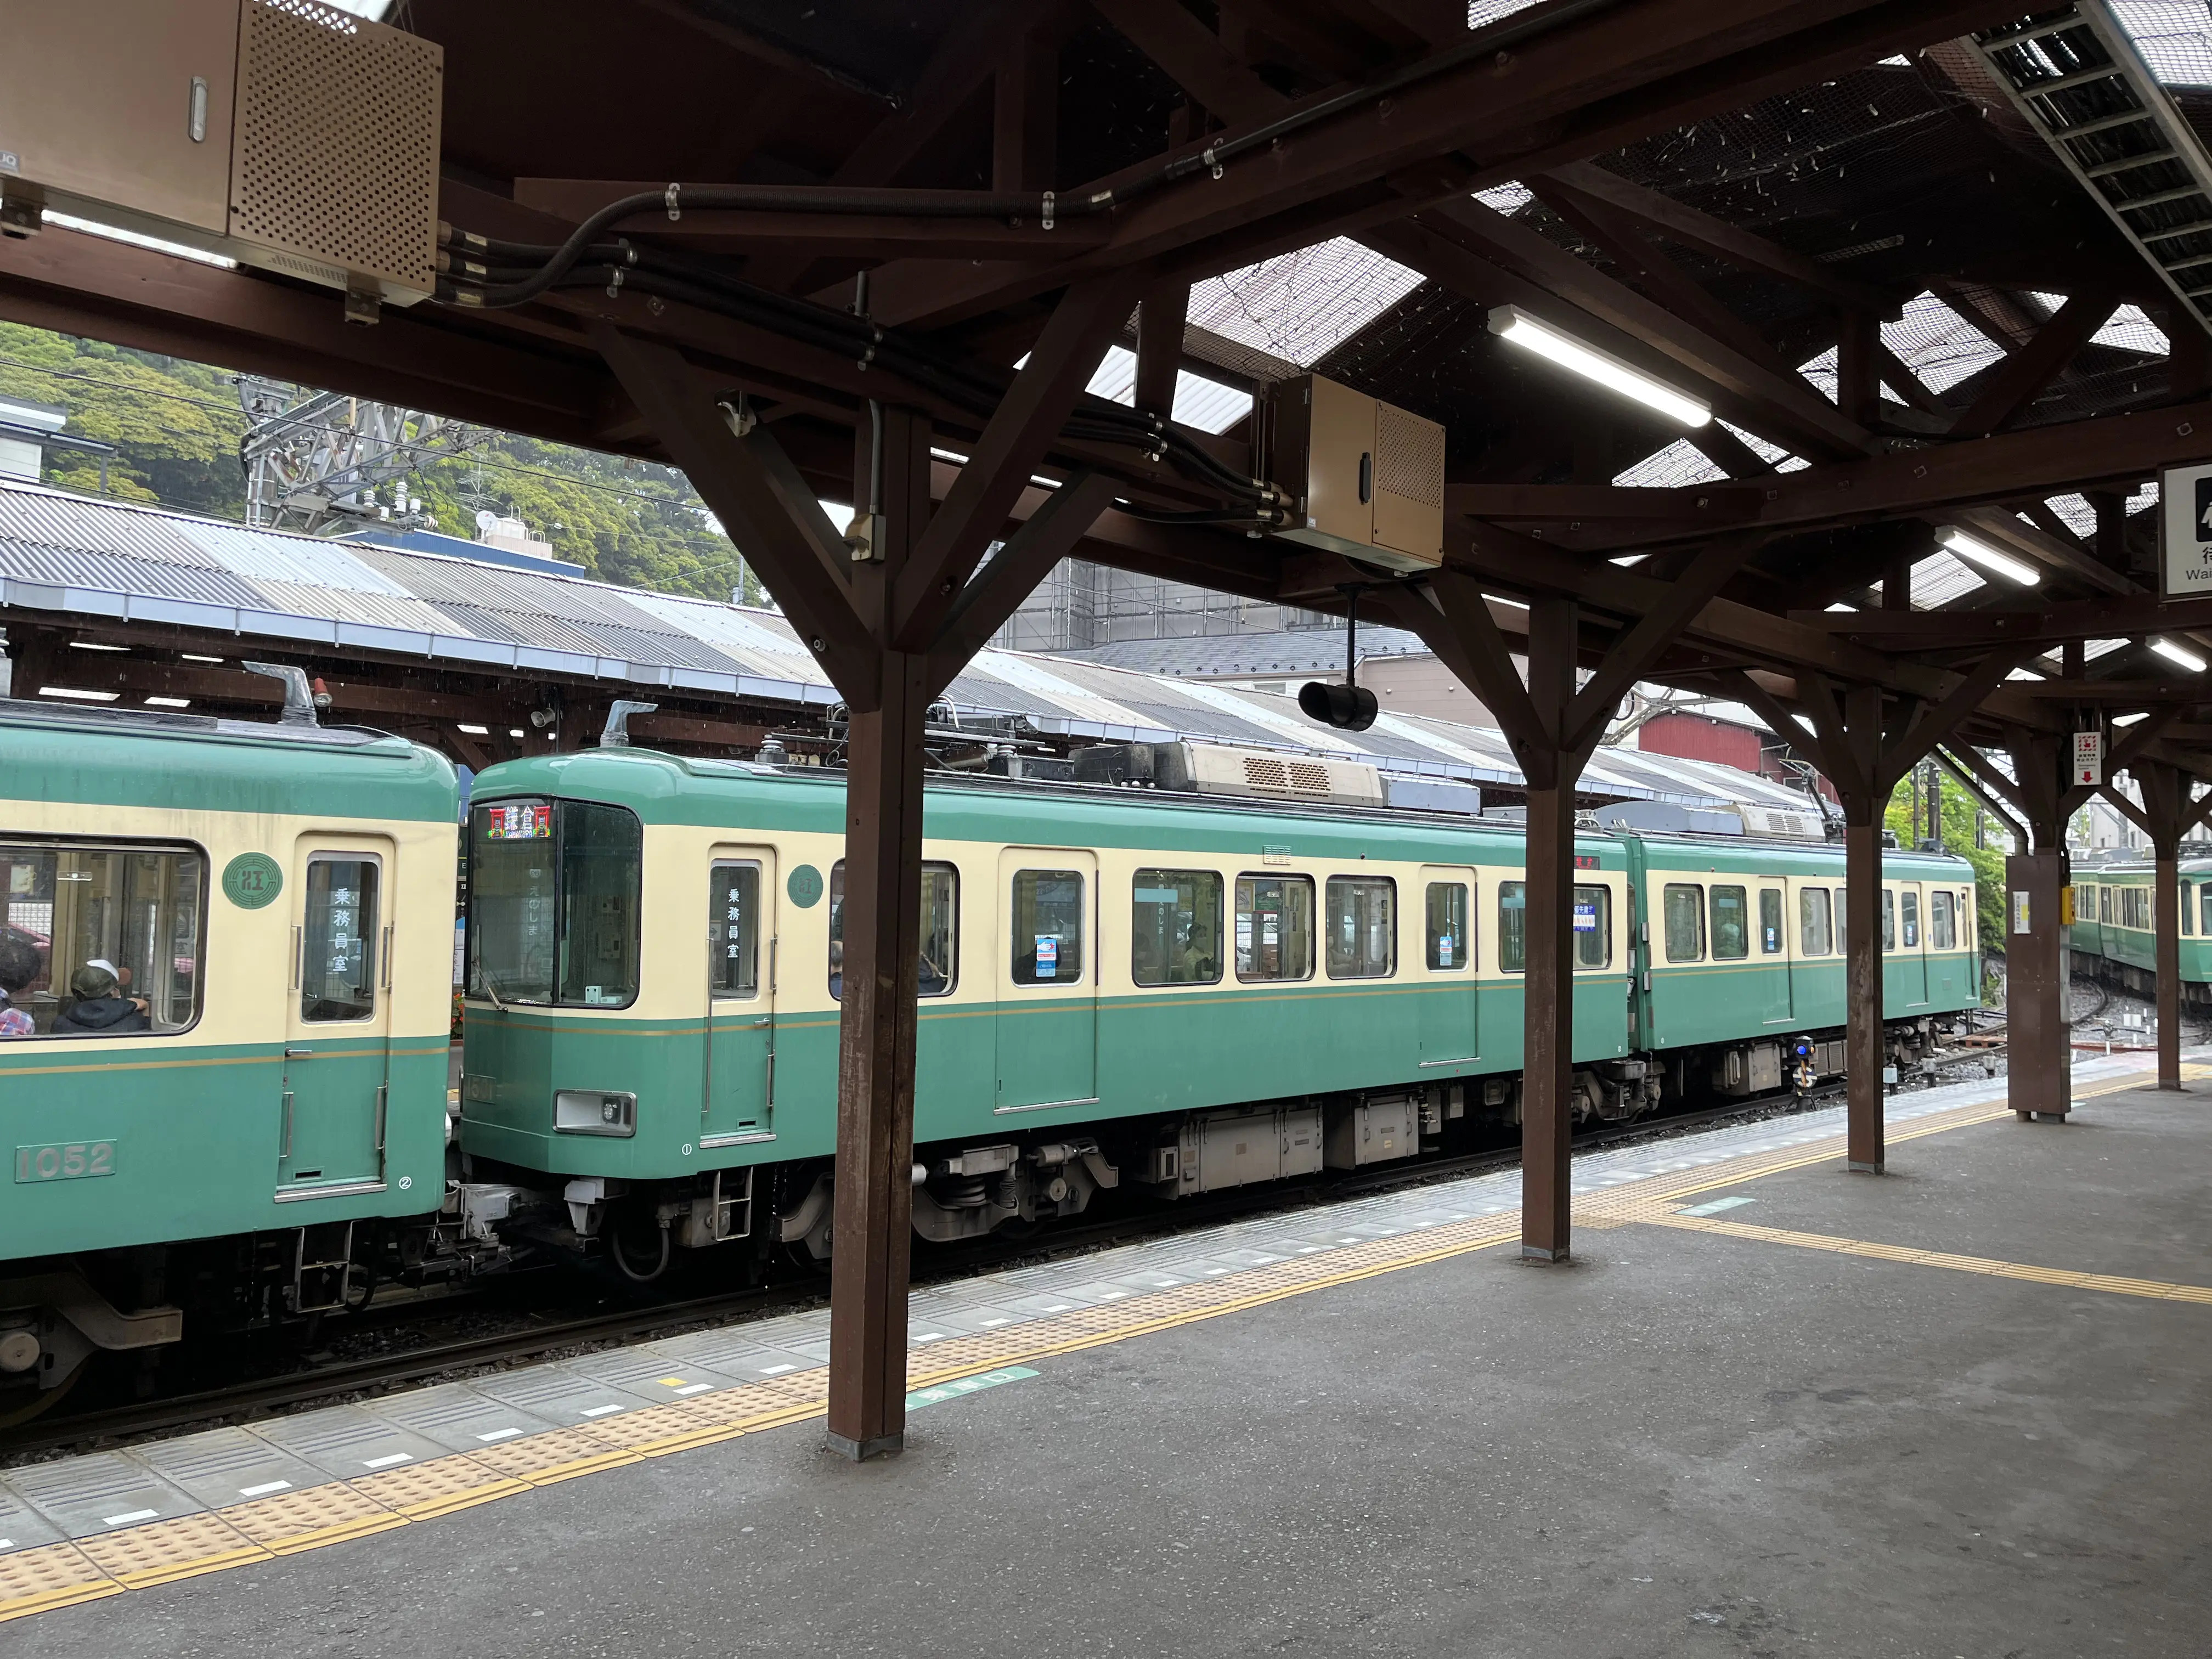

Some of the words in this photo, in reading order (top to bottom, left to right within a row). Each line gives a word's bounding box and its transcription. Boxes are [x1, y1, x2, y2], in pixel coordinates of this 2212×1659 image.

[332, 887, 351, 972] 乗務員室
[727, 888, 740, 958] 乗務員室
[20, 1143, 112, 1180] 1052
